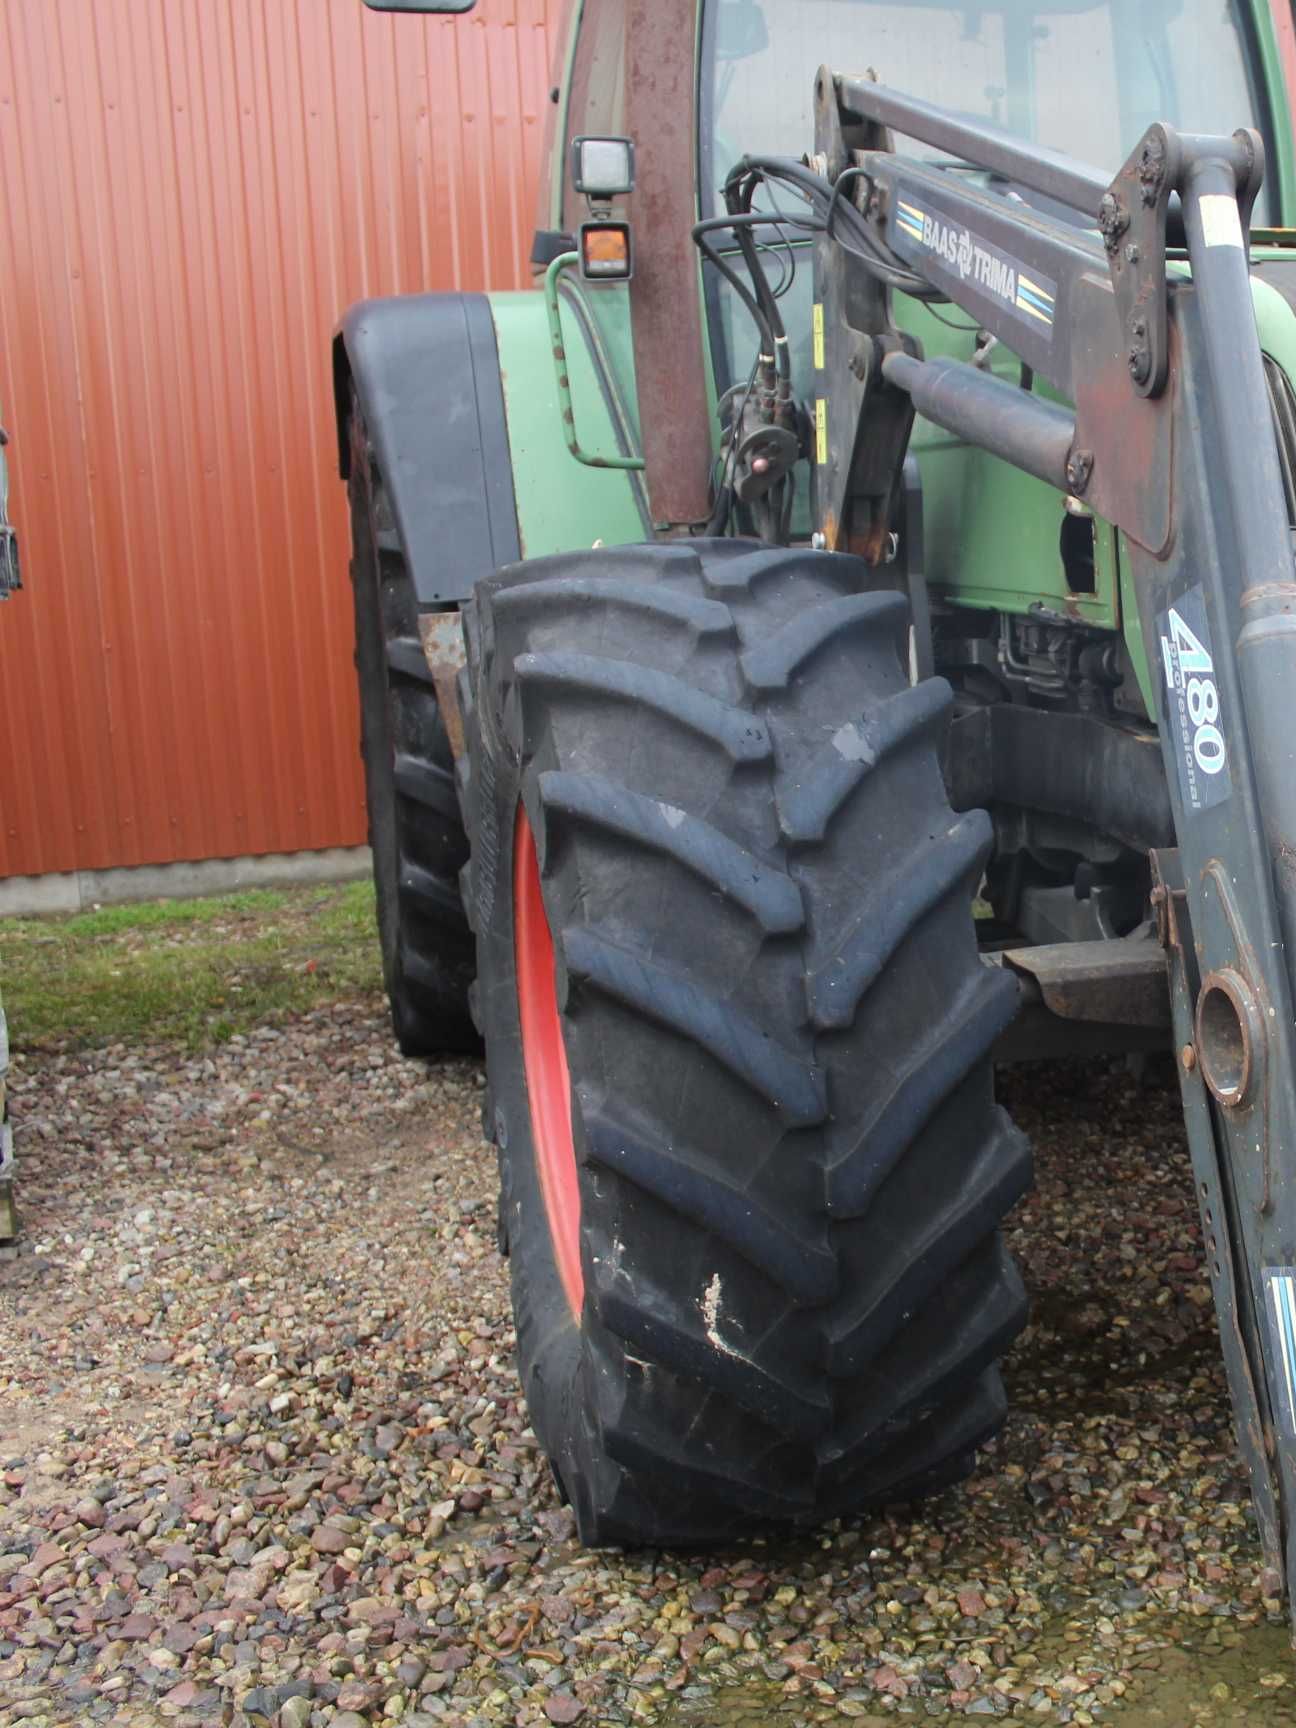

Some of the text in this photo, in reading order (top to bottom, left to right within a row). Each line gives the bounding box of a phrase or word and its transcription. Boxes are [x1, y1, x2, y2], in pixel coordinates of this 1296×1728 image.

[923, 215, 1016, 305] BAAS TRIMA
[1161, 608, 1226, 775] 480
[1168, 640, 1202, 808] professional
